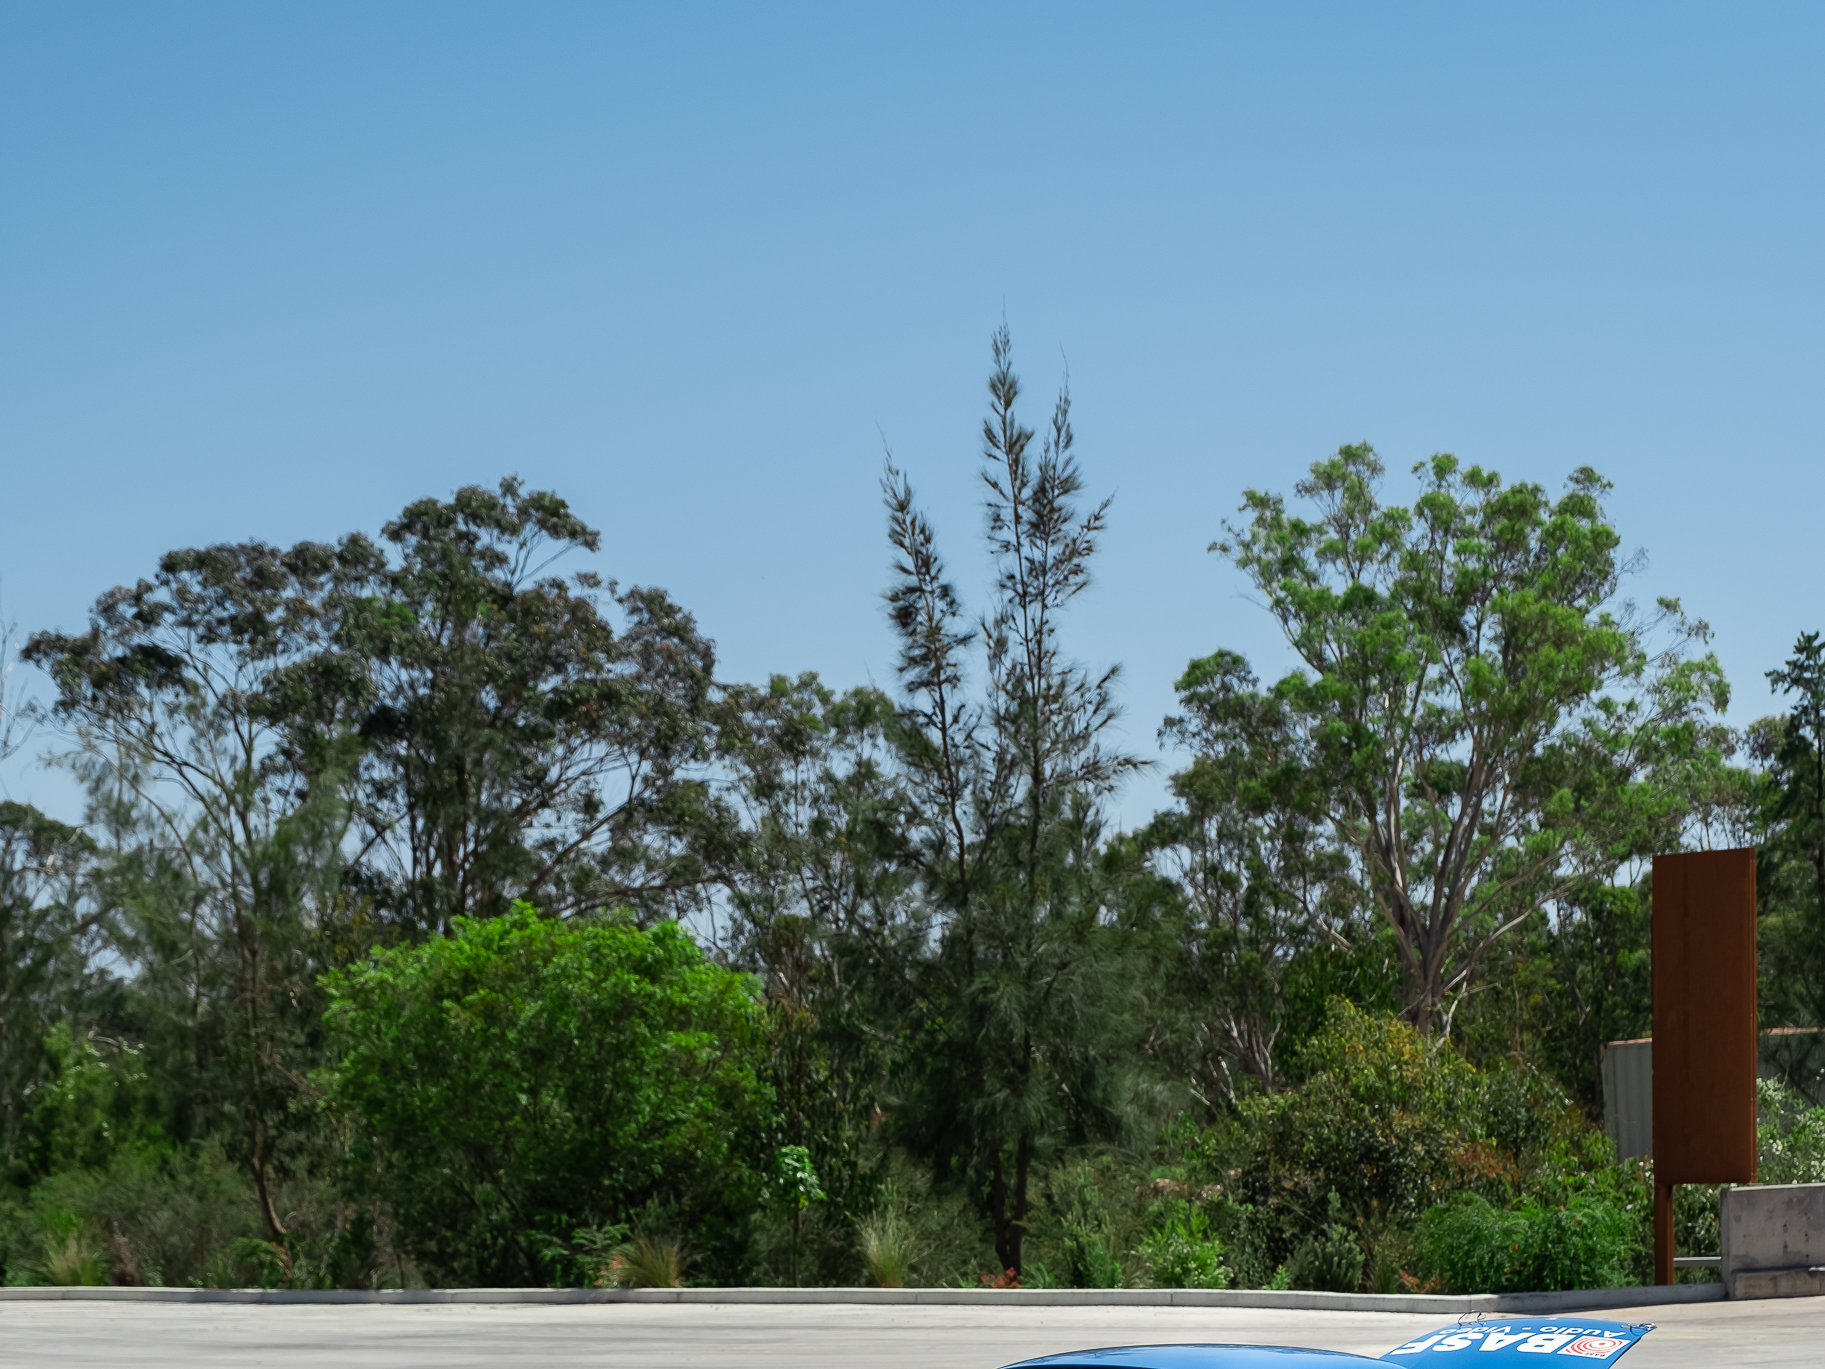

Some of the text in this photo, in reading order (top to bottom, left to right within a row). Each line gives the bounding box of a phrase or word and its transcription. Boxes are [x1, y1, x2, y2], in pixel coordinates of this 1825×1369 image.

[1445, 1326, 1513, 1335] Video
[1539, 1326, 1627, 1338] Audio
[1389, 1332, 1572, 1356] BASF
